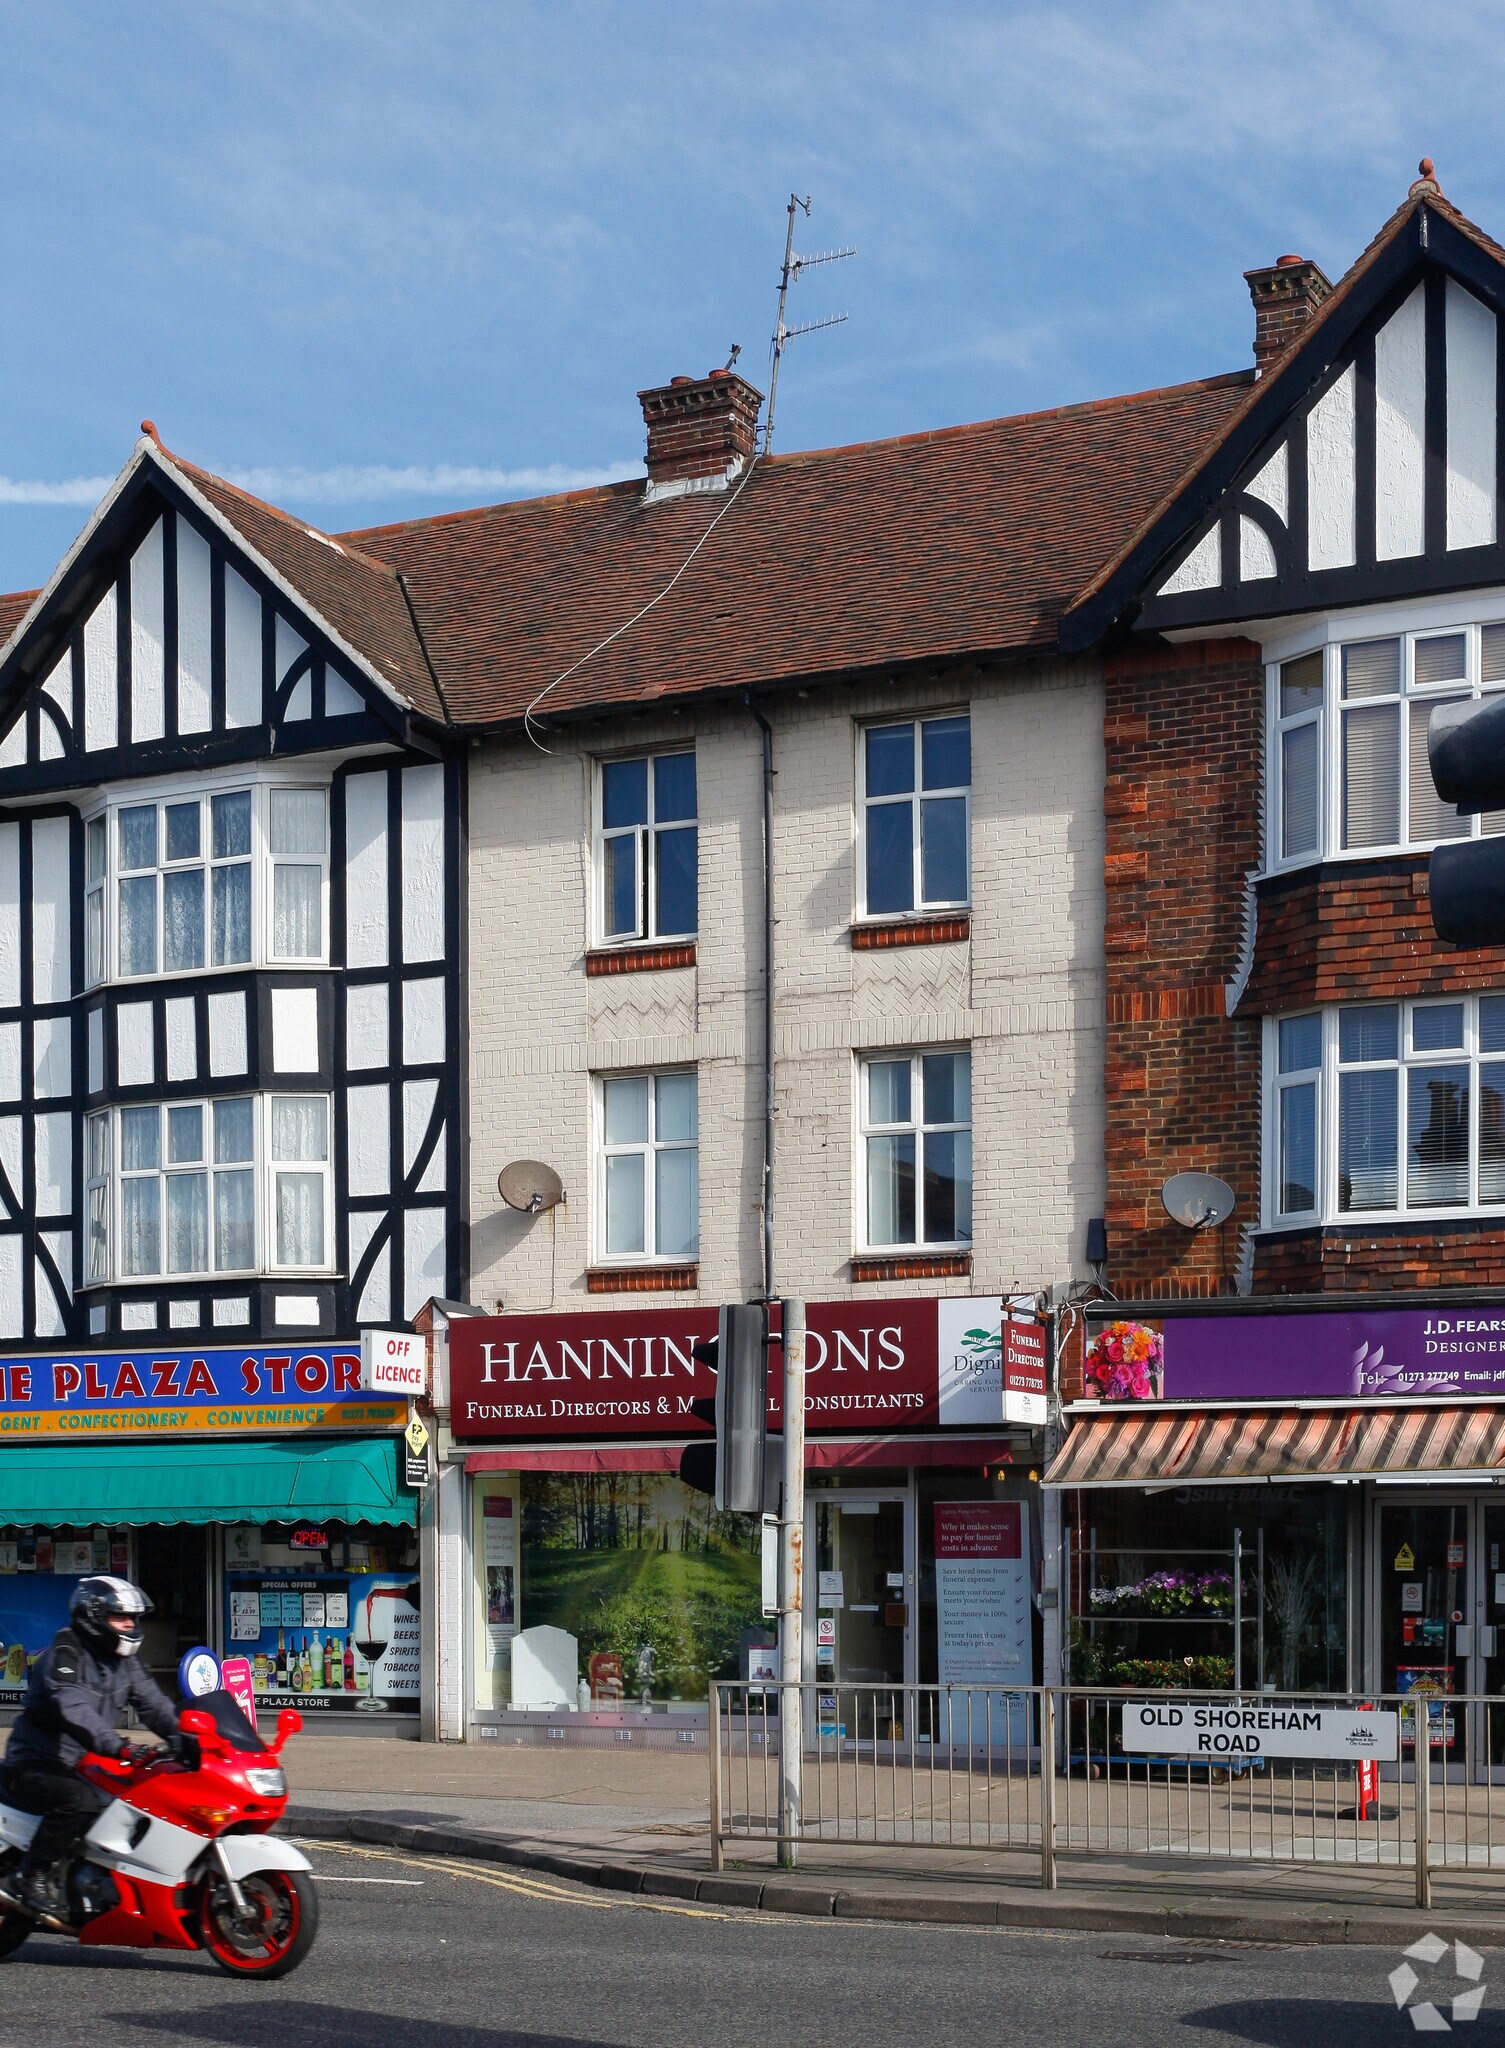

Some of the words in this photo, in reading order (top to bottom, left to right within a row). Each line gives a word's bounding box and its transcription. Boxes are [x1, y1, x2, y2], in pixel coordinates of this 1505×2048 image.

[1010, 1328, 1041, 1349] FUNERAL
[387, 1339, 410, 1357] OFF
[479, 1325, 906, 1383] HANNINONS
[1007, 1347, 1045, 1368] DIRECTORS
[953, 1354, 1002, 1376] Digni
[52, 1359, 220, 1402] PLAZA
[240, 1354, 362, 1396] STOR
[375, 1364, 421, 1384] LICENCE
[1398, 1372, 1425, 1382] 01273
[1427, 1371, 1459, 1382] 277249
[1464, 1371, 1491, 1381] Email:
[1009, 1374, 1025, 1387] 01273
[466, 1402, 547, 1419] FUNERAL
[550, 1399, 651, 1417] DIRECTORS
[656, 1395, 671, 1414] &
[803, 1393, 924, 1411] ONSULTANTS
[59, 1412, 190, 1429] CONFECTIONERY
[207, 1408, 325, 1425] CONVENIENCE
[941, 1523, 959, 1532] Why
[966, 1523, 989, 1531] makes
[293, 1531, 327, 1545] OPEN
[950, 1535, 963, 1543] pay
[964, 1533, 975, 1541] for
[976, 1533, 1002, 1541] funeral
[969, 1543, 998, 1552] advance
[261, 1581, 289, 1589] SPECIAL
[291, 1581, 317, 1589] OFFERS
[980, 1596, 1000, 1604] wishes
[393, 1614, 419, 1623] WINES
[960, 1611, 982, 1619] money
[990, 1610, 1008, 1618] 100%
[394, 1631, 419, 1640] BEERS
[966, 1631, 989, 1639] funeral
[974, 1640, 994, 1648] prices
[389, 1646, 420, 1656] SPIRITS
[383, 1662, 420, 1672] TOBACCO
[387, 1679, 420, 1689] SWEETS
[1, 1692, 18, 1700] THE
[262, 1697, 294, 1706] PLAZA
[294, 1698, 331, 1707] STORE
[999, 1700, 1024, 1709] Dgnity
[1139, 1707, 1184, 1727] OLD
[1193, 1709, 1322, 1731] SHOREHAM
[1198, 1733, 1261, 1753] ROAD
